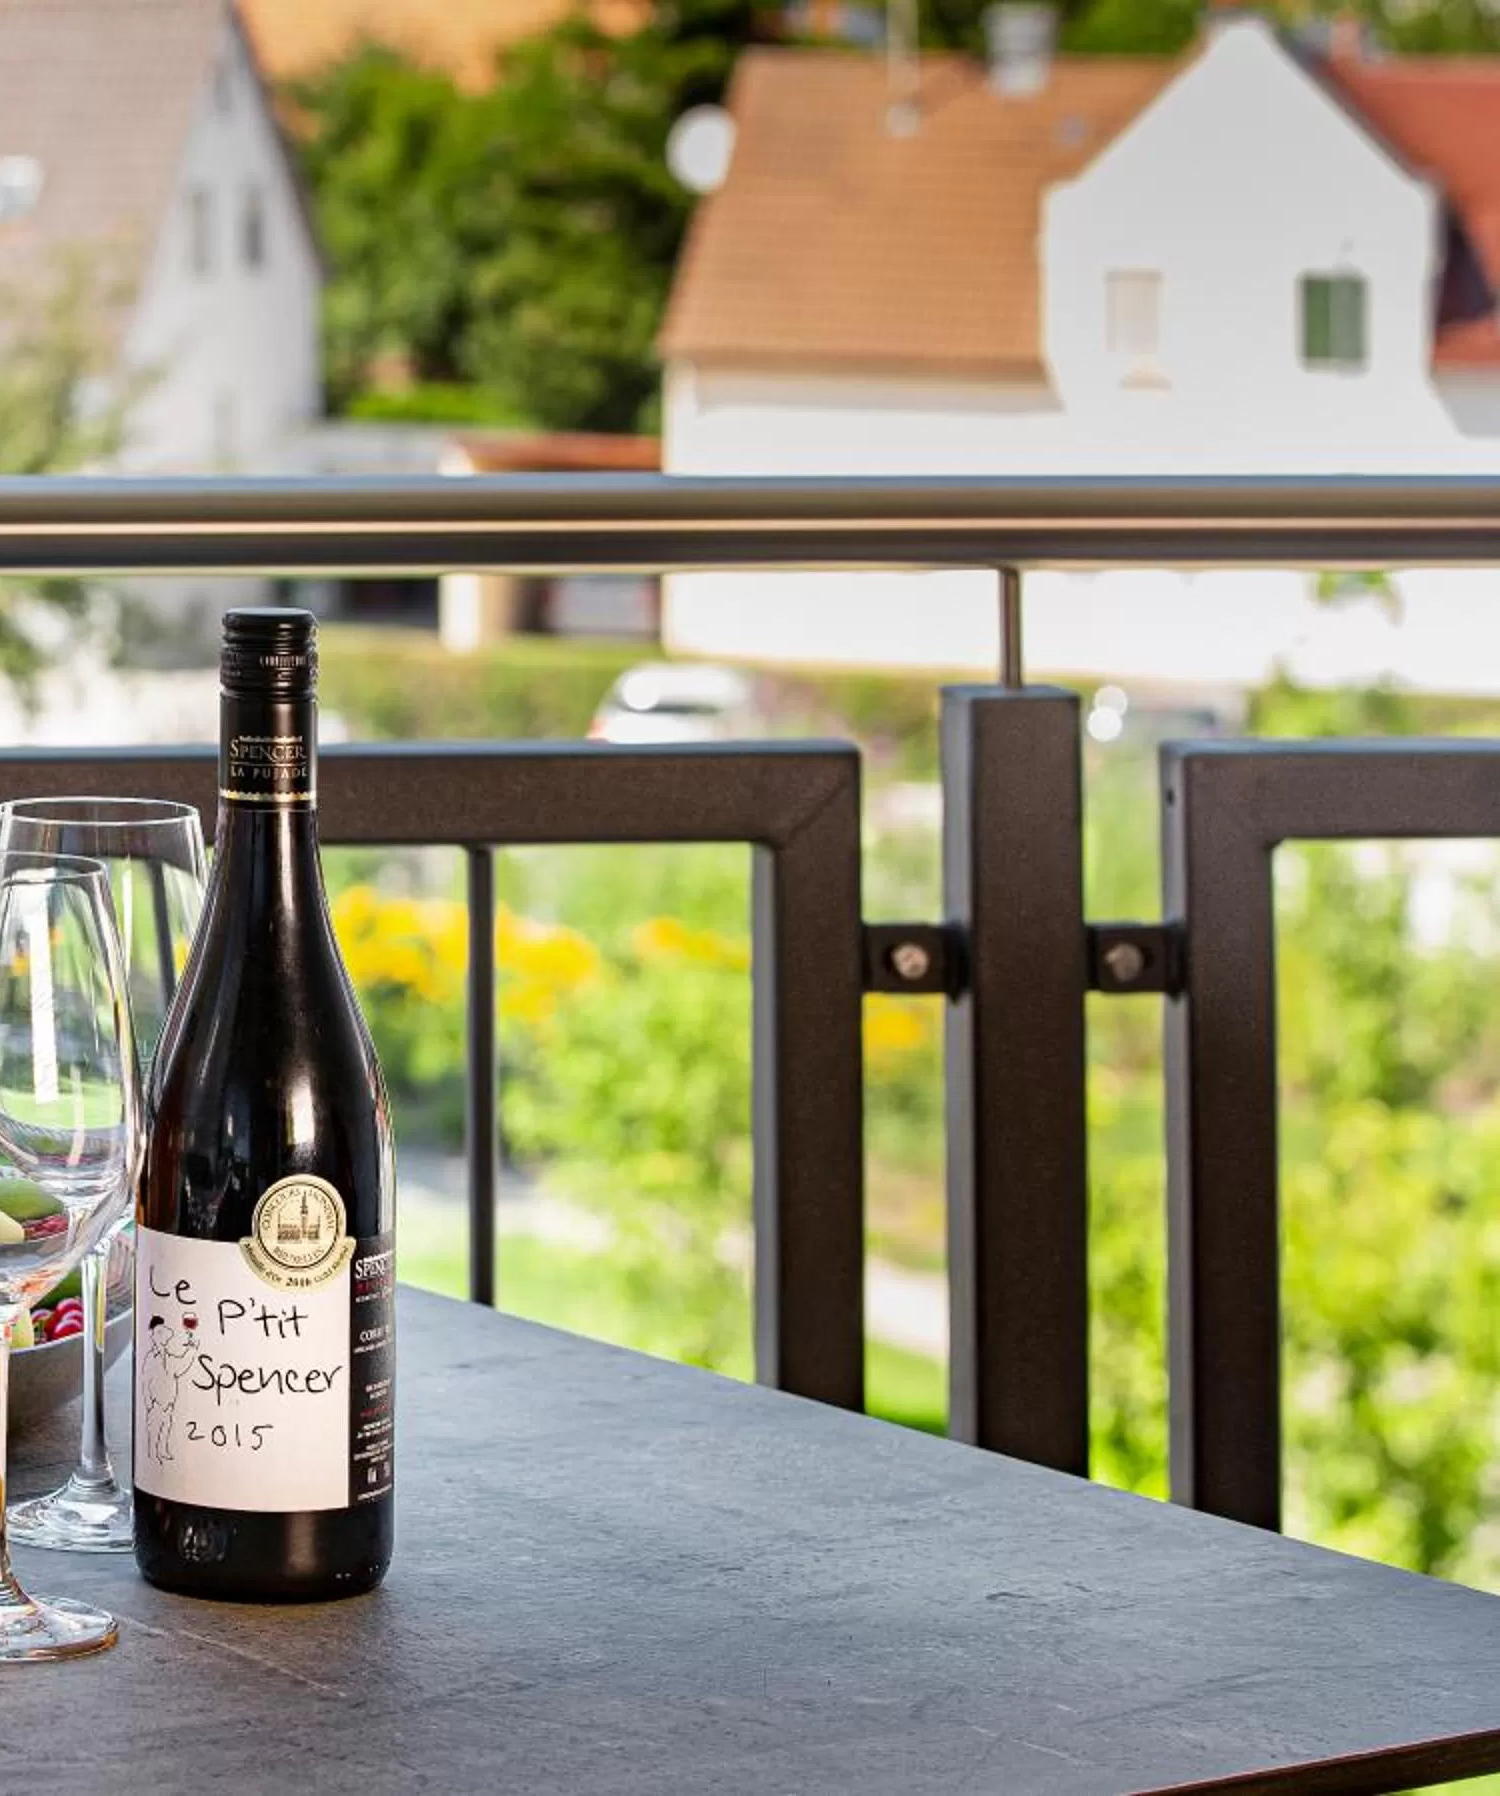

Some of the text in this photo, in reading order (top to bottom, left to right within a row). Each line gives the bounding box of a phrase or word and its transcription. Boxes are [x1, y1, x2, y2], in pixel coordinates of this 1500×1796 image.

[229, 739, 308, 763] SPENCER
[230, 765, 245, 778] LA
[149, 1264, 197, 1305] Le
[217, 1297, 309, 1339] P'tit
[191, 1354, 343, 1406] Spencer
[185, 1420, 275, 1451] 2015
